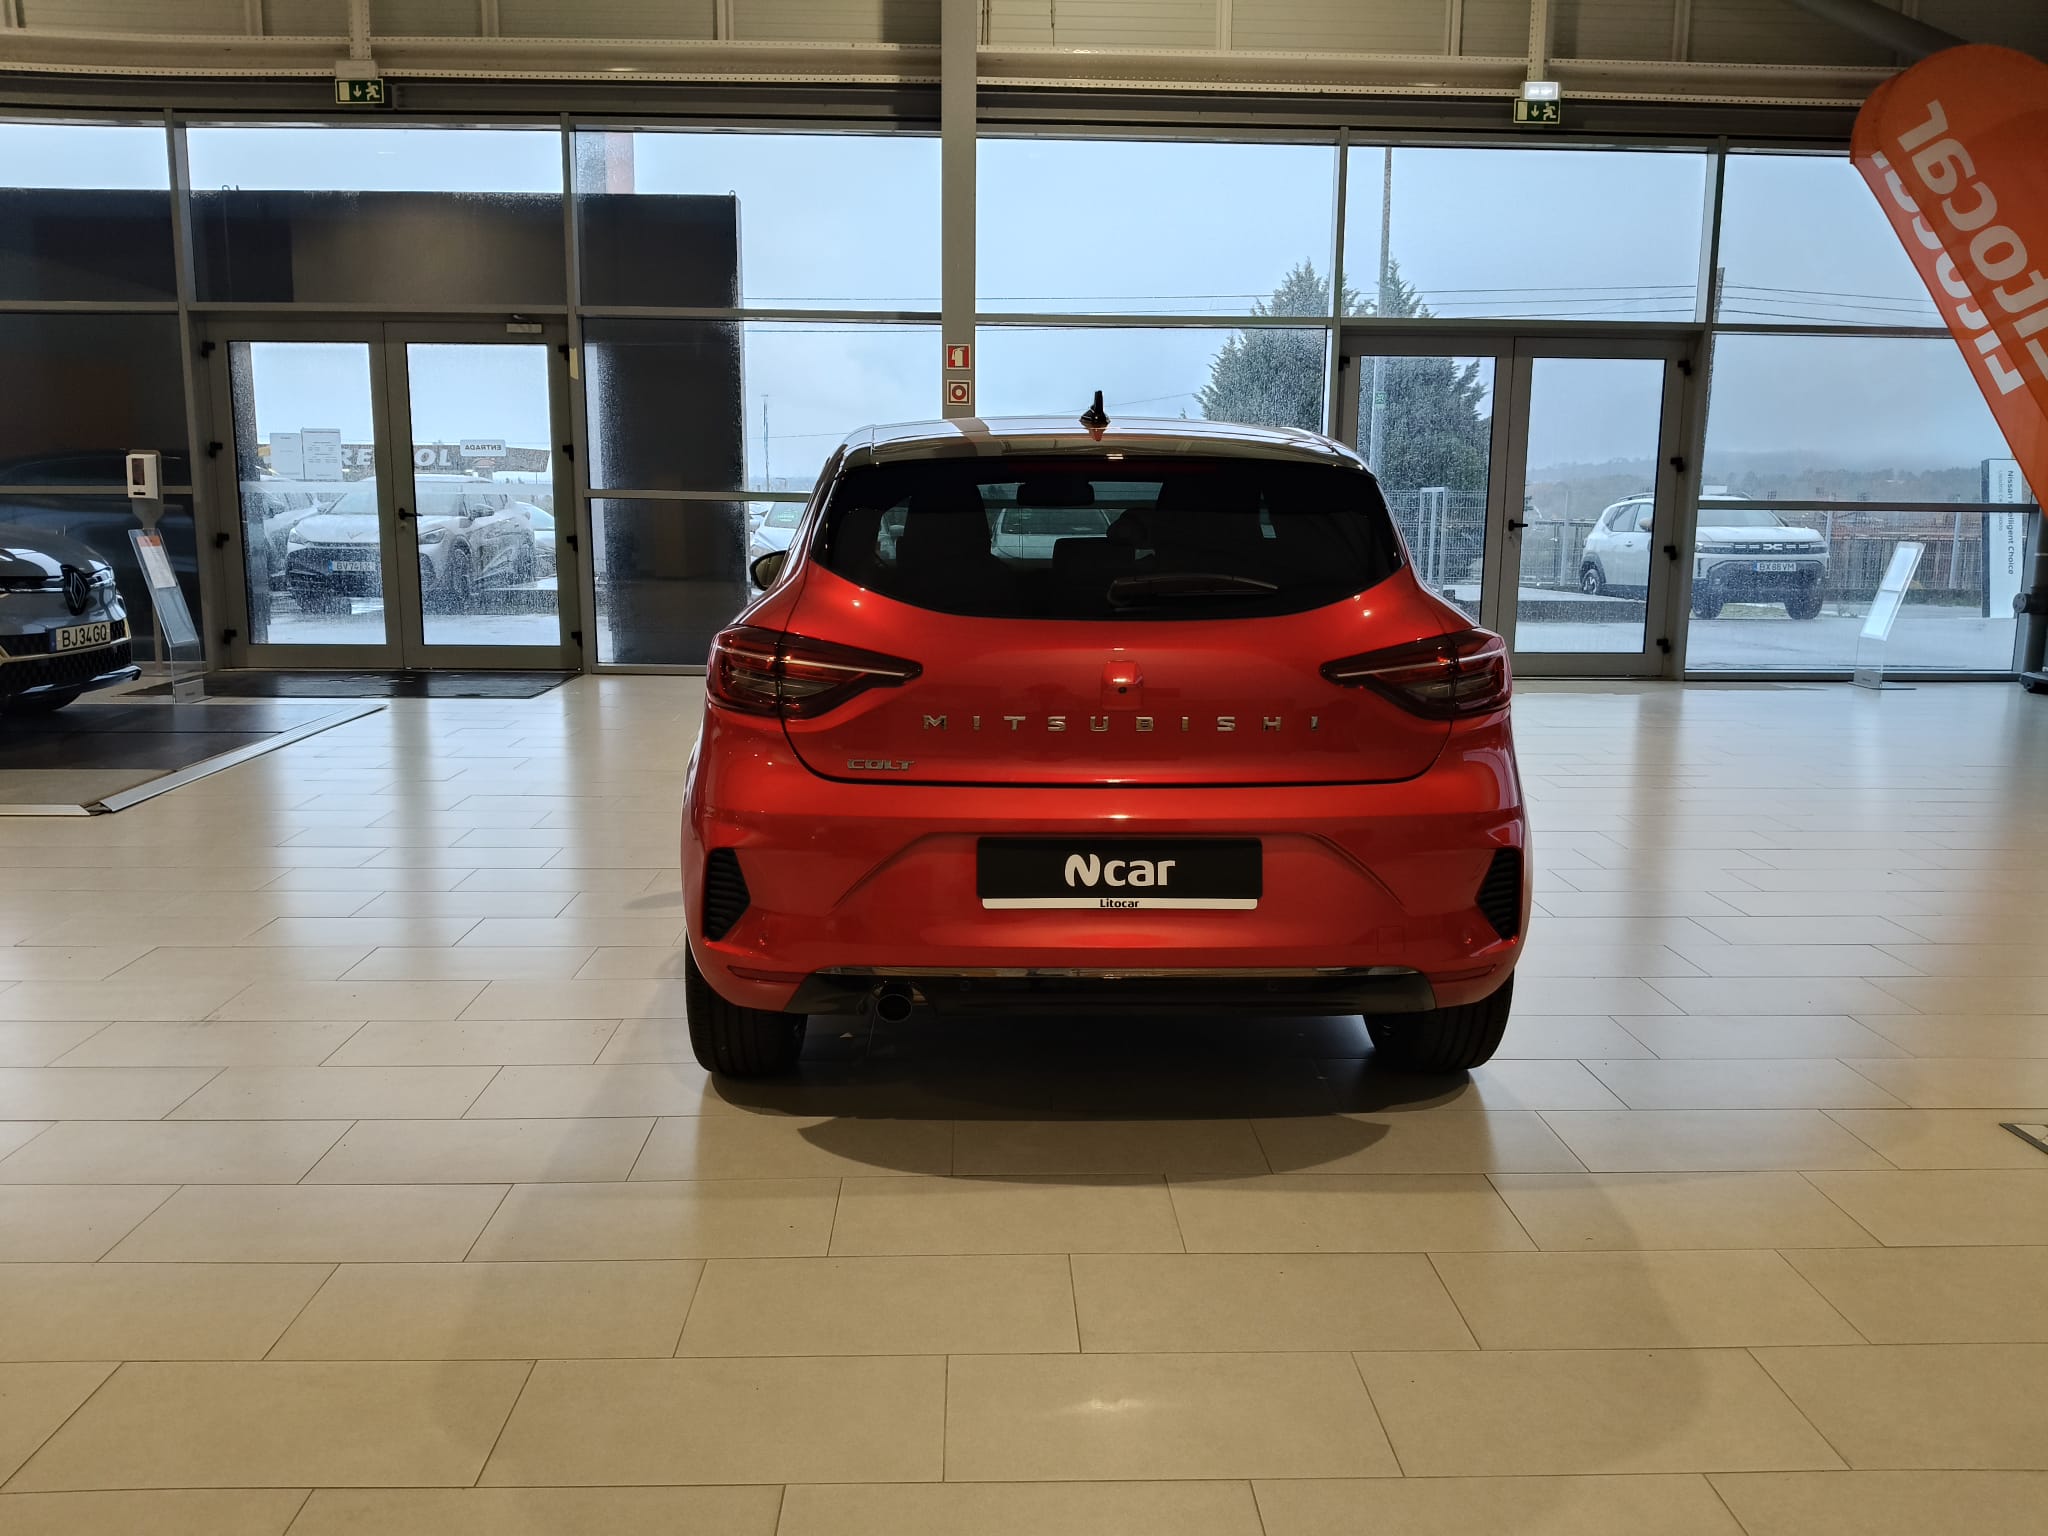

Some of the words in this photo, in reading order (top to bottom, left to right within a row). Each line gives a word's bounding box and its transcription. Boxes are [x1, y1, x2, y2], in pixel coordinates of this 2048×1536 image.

[2007, 546, 2015, 575] Choice
[62, 624, 107, 648] BJ34GQ
[922, 714, 1319, 732] MITSUBISHI
[847, 759, 915, 770] COLT
[1065, 853, 1176, 887] Ncar
[1100, 899, 1139, 908] Litocar
